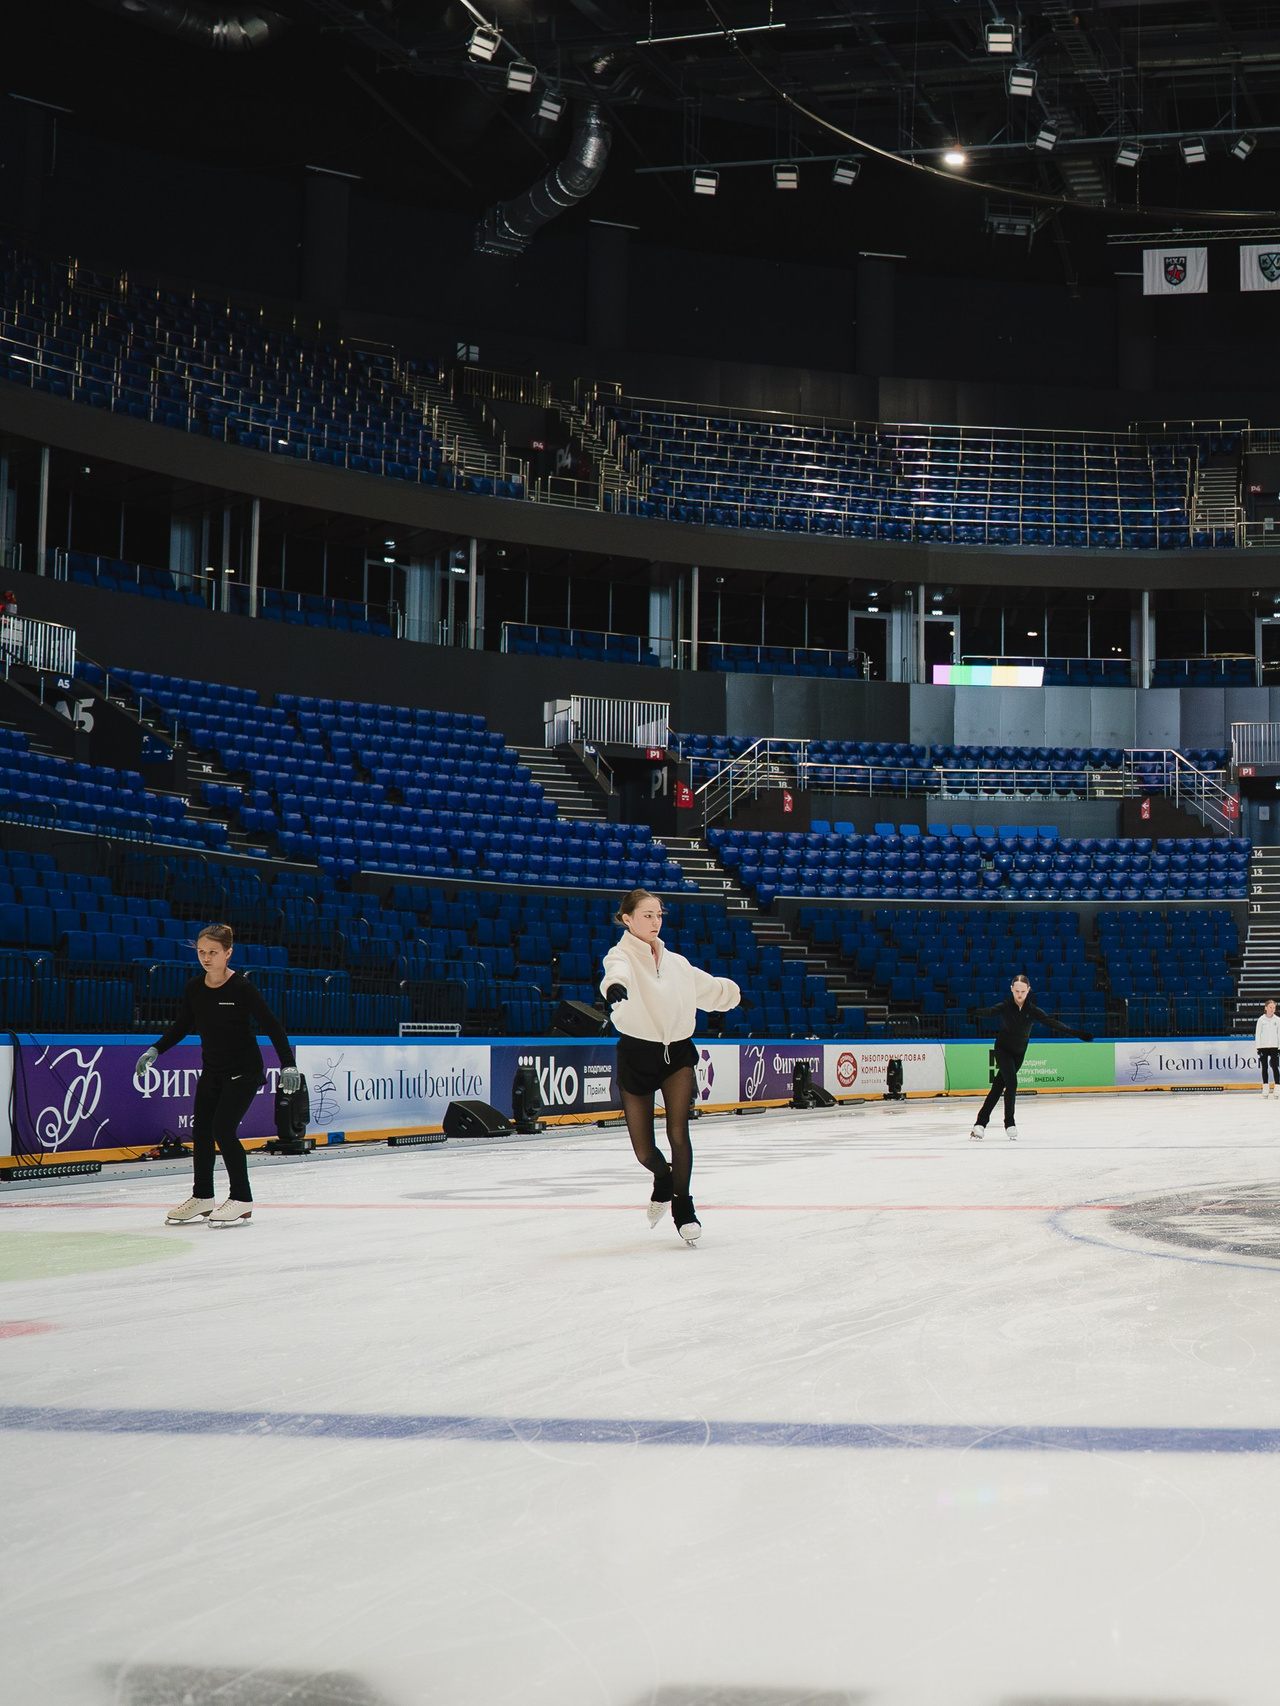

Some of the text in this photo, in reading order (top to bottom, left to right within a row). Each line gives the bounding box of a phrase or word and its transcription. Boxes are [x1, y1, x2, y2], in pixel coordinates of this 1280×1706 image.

[650, 751, 660, 759] P1
[1242, 767, 1252, 775] P1
[690, 841, 700, 849] 14
[1253, 850, 1263, 858] 14
[706, 862, 716, 870] 13
[1253, 868, 1263, 876] 13
[722, 880, 732, 889] 12
[1253, 886, 1263, 894] 12
[740, 900, 748, 909] 11
[1157, 1054, 1202, 1071] Team
[589, 1065, 611, 1073] подписке
[699, 1069, 706, 1080] TV
[343, 1067, 483, 1101] Team Tutberidze
[586, 1084, 608, 1096] Прайм
